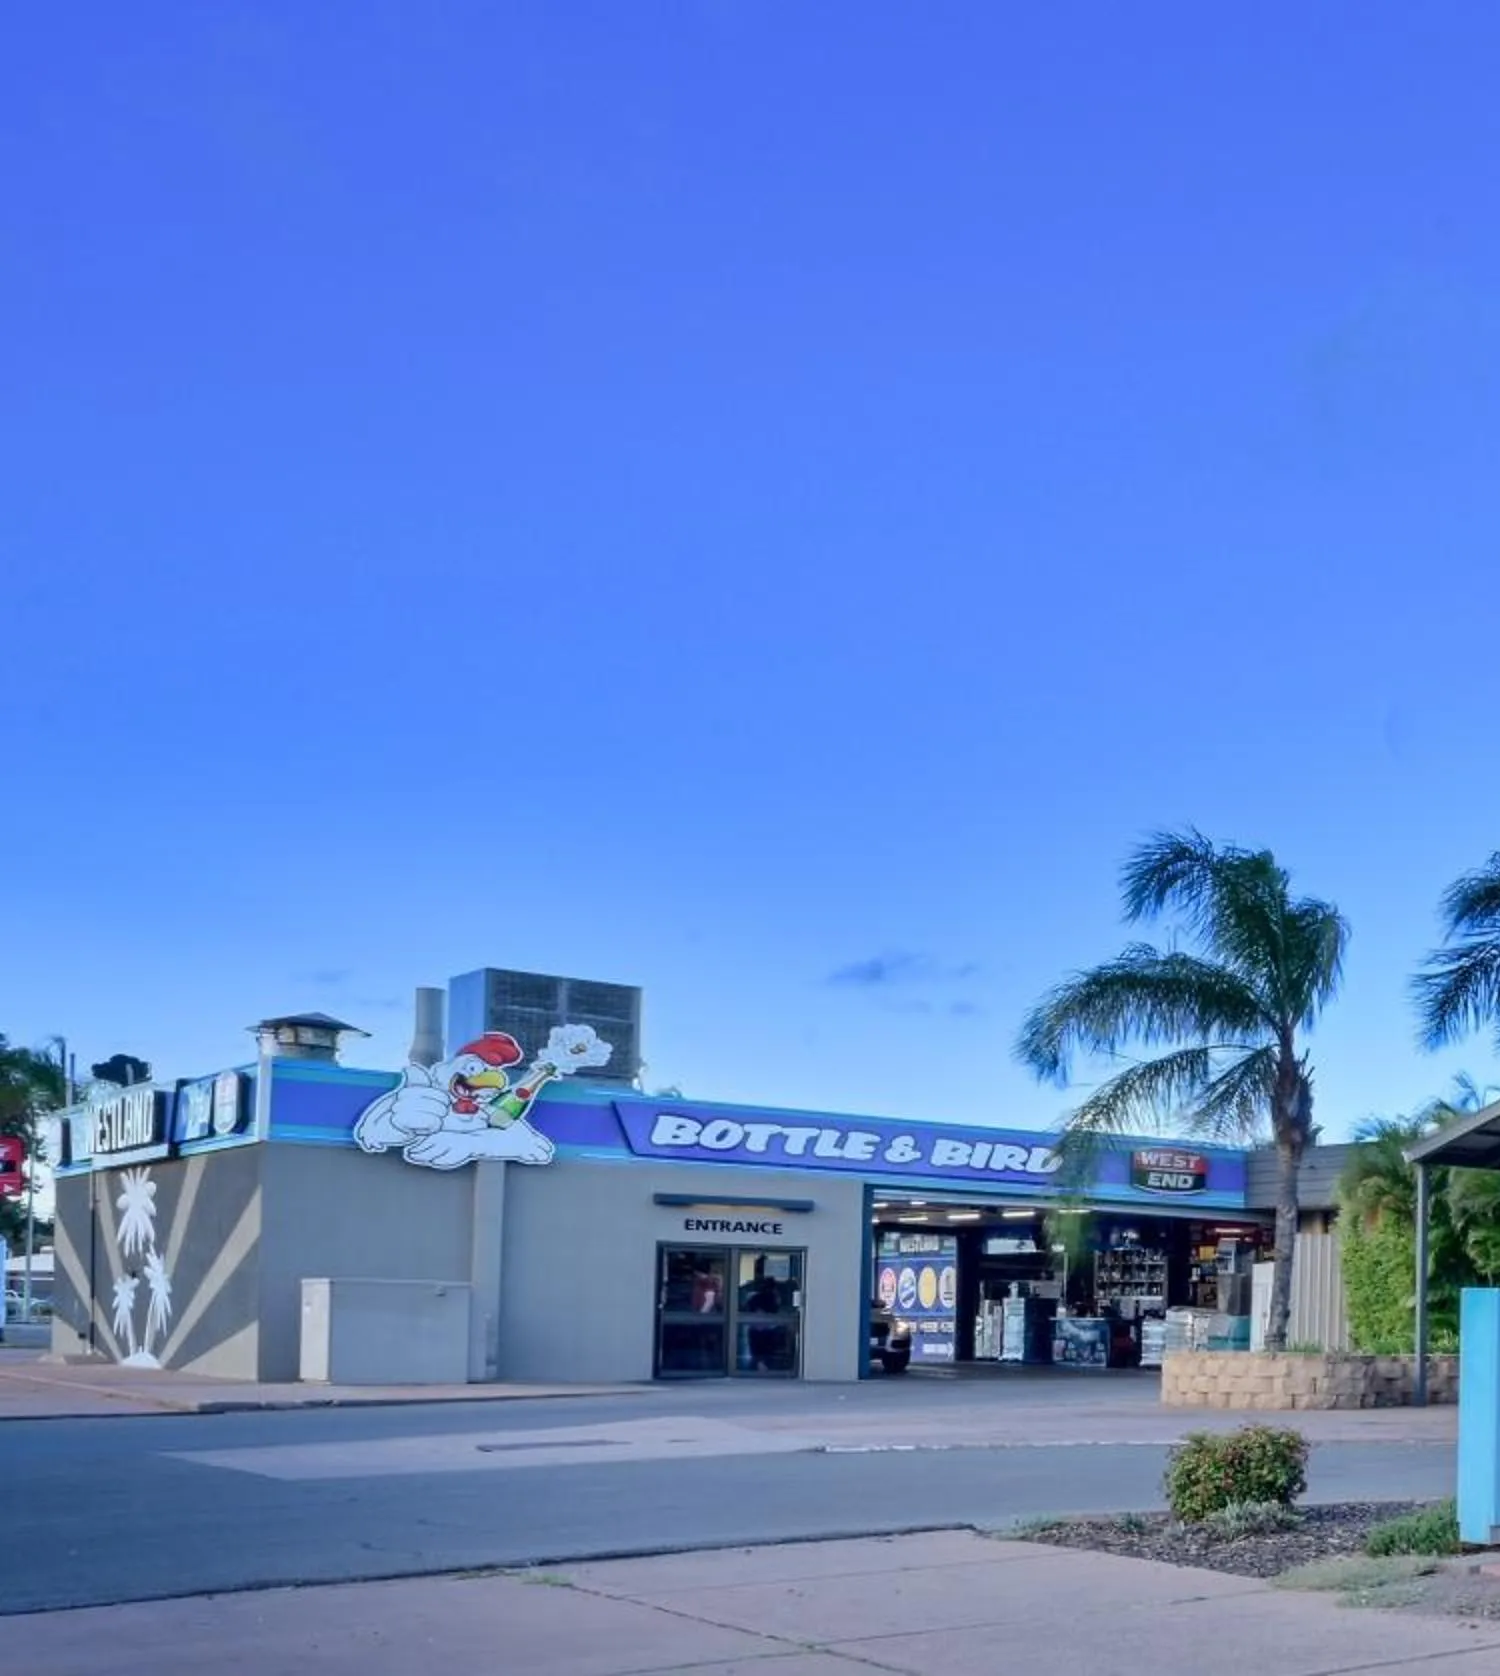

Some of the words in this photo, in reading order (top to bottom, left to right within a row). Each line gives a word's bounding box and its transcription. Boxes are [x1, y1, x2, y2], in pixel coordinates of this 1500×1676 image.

[651, 1114, 880, 1161] BOTTLE
[884, 1135, 921, 1163] &
[1137, 1151, 1201, 1169] WEST
[1147, 1171, 1195, 1189] END
[684, 1218, 784, 1235] ENTRANCE
